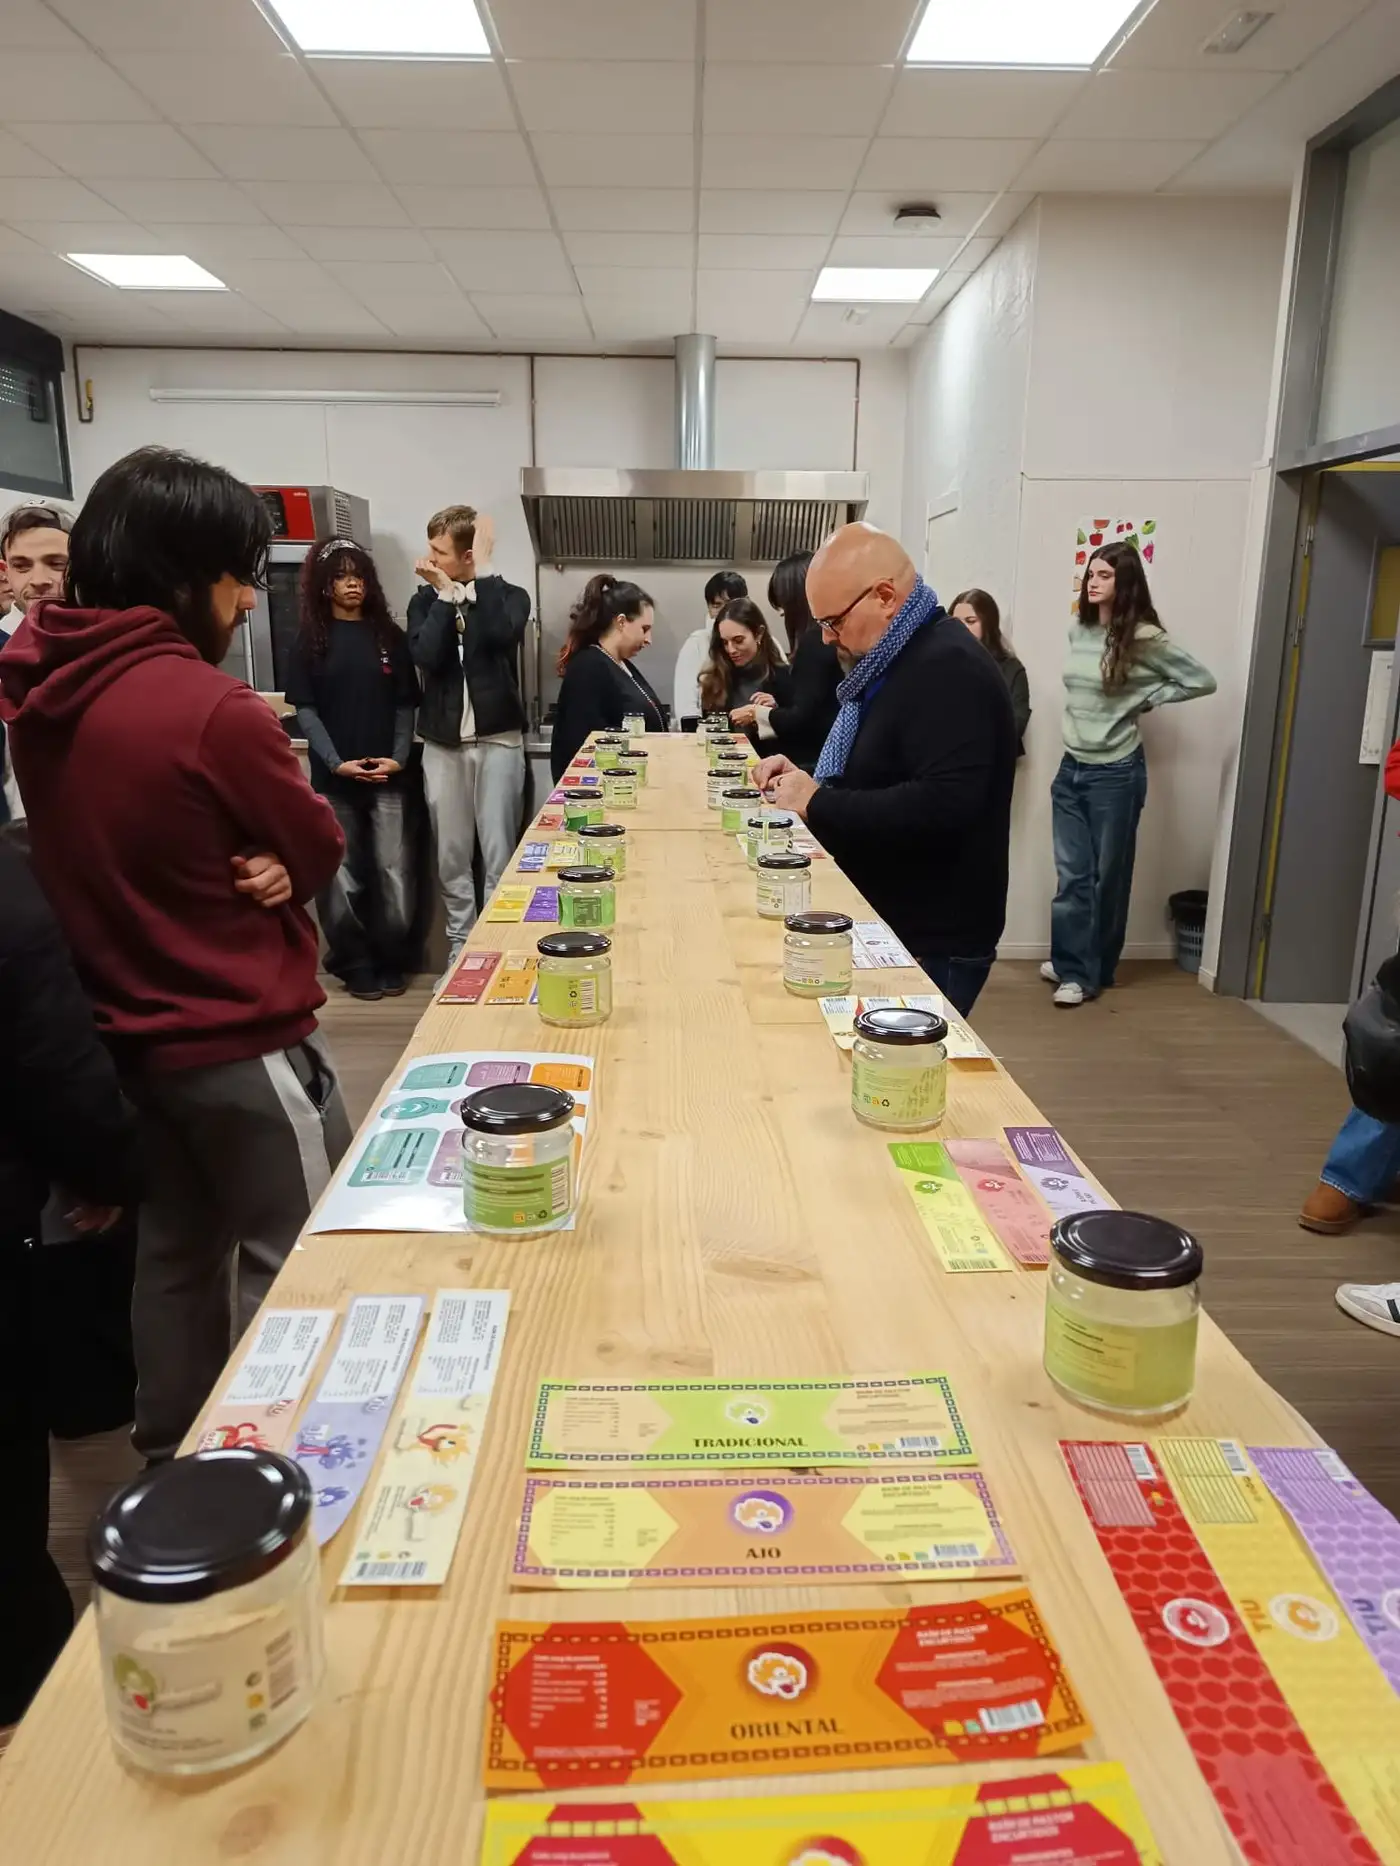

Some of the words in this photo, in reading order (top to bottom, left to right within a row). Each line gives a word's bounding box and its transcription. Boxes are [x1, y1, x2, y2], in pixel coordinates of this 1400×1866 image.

[692, 1437, 808, 1448] TRADICIONAL
[745, 1547, 782, 1560] AJO
[730, 1717, 844, 1741] ORIENTAL
